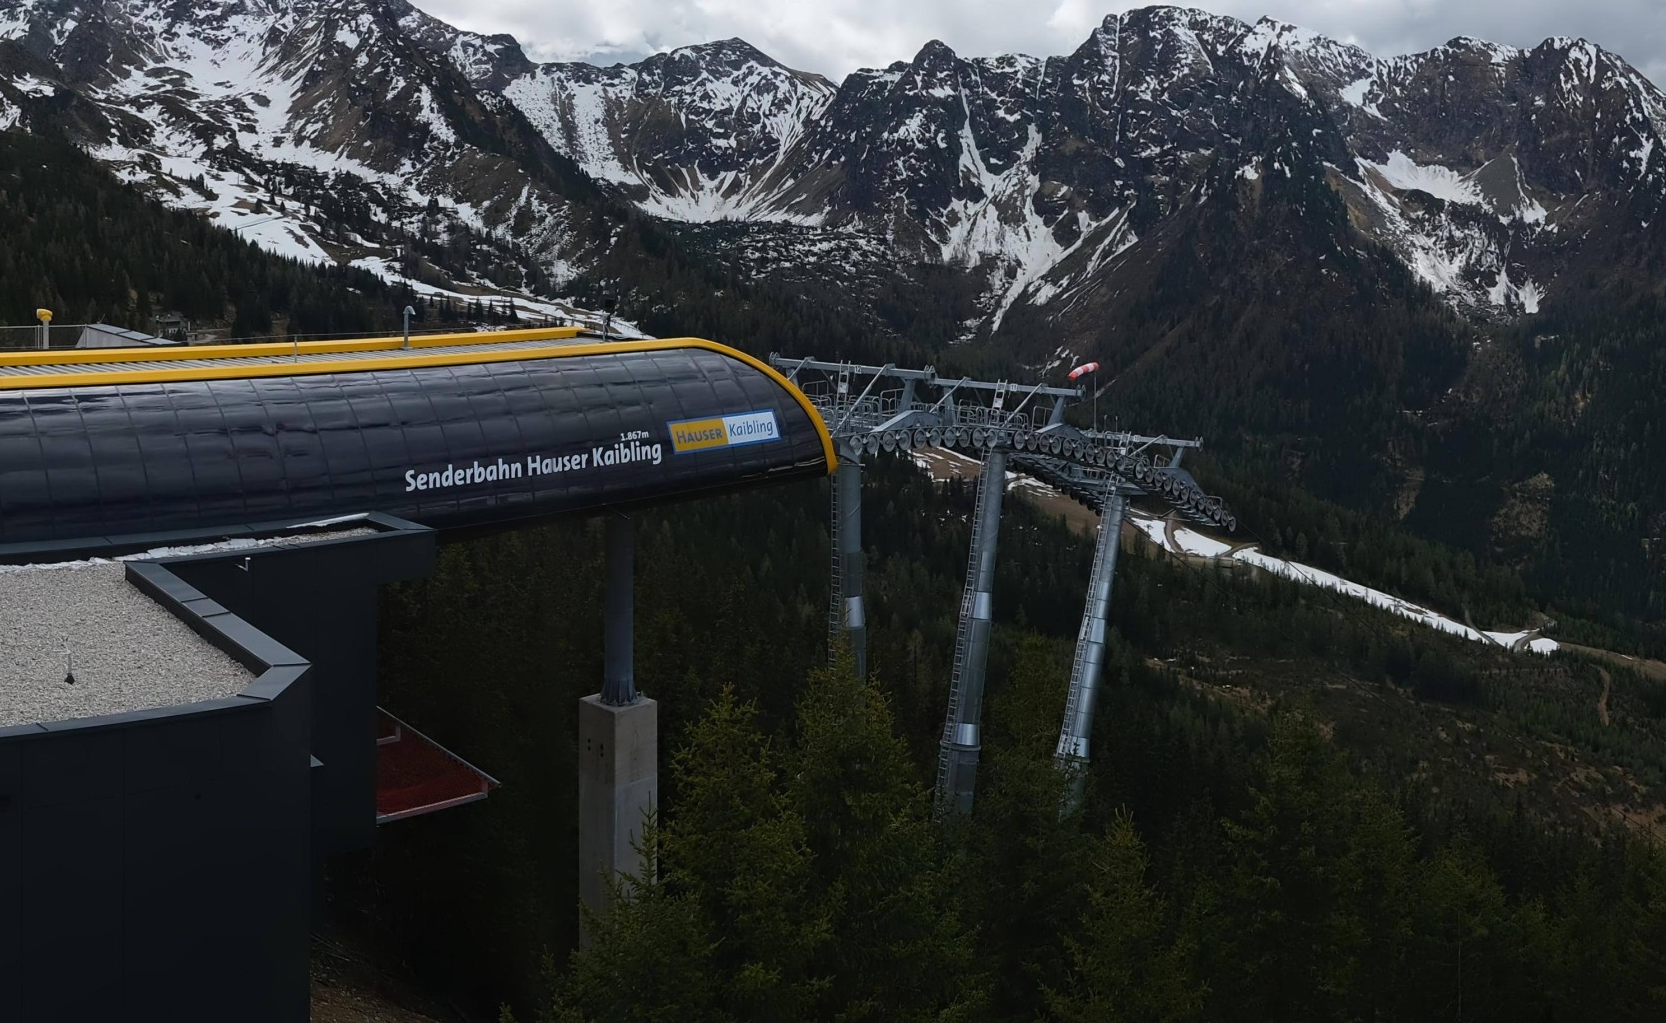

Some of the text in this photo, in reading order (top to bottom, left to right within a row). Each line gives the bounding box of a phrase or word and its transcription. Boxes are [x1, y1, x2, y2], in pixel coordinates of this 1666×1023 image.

[620, 430, 650, 441] 1.867m
[676, 420, 773, 444] HAUSER Kaibling
[405, 440, 662, 492] Senderbahn Hauser Kaibling
